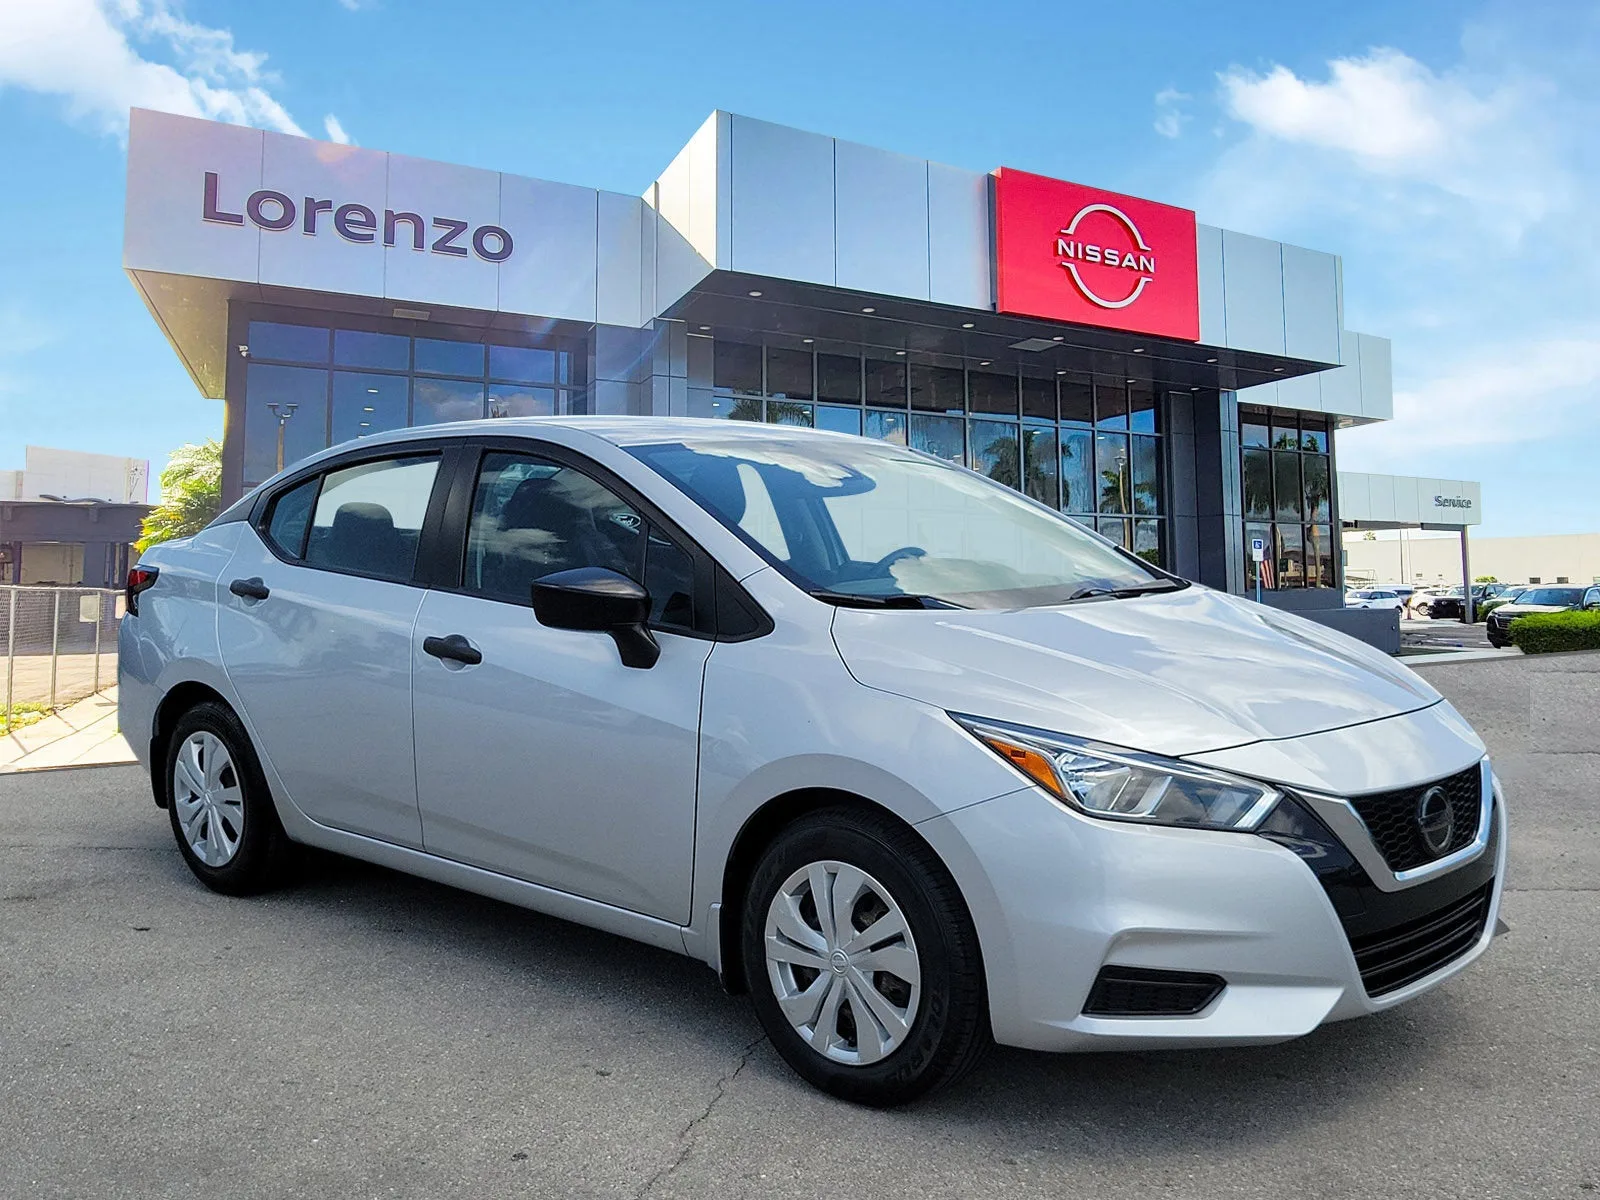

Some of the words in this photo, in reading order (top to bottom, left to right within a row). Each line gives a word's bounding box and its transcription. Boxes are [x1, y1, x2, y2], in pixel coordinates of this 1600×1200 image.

[202, 171, 515, 263] Lorenzo
[1057, 238, 1155, 273] NISSAN
[1434, 495, 1472, 509] Service
